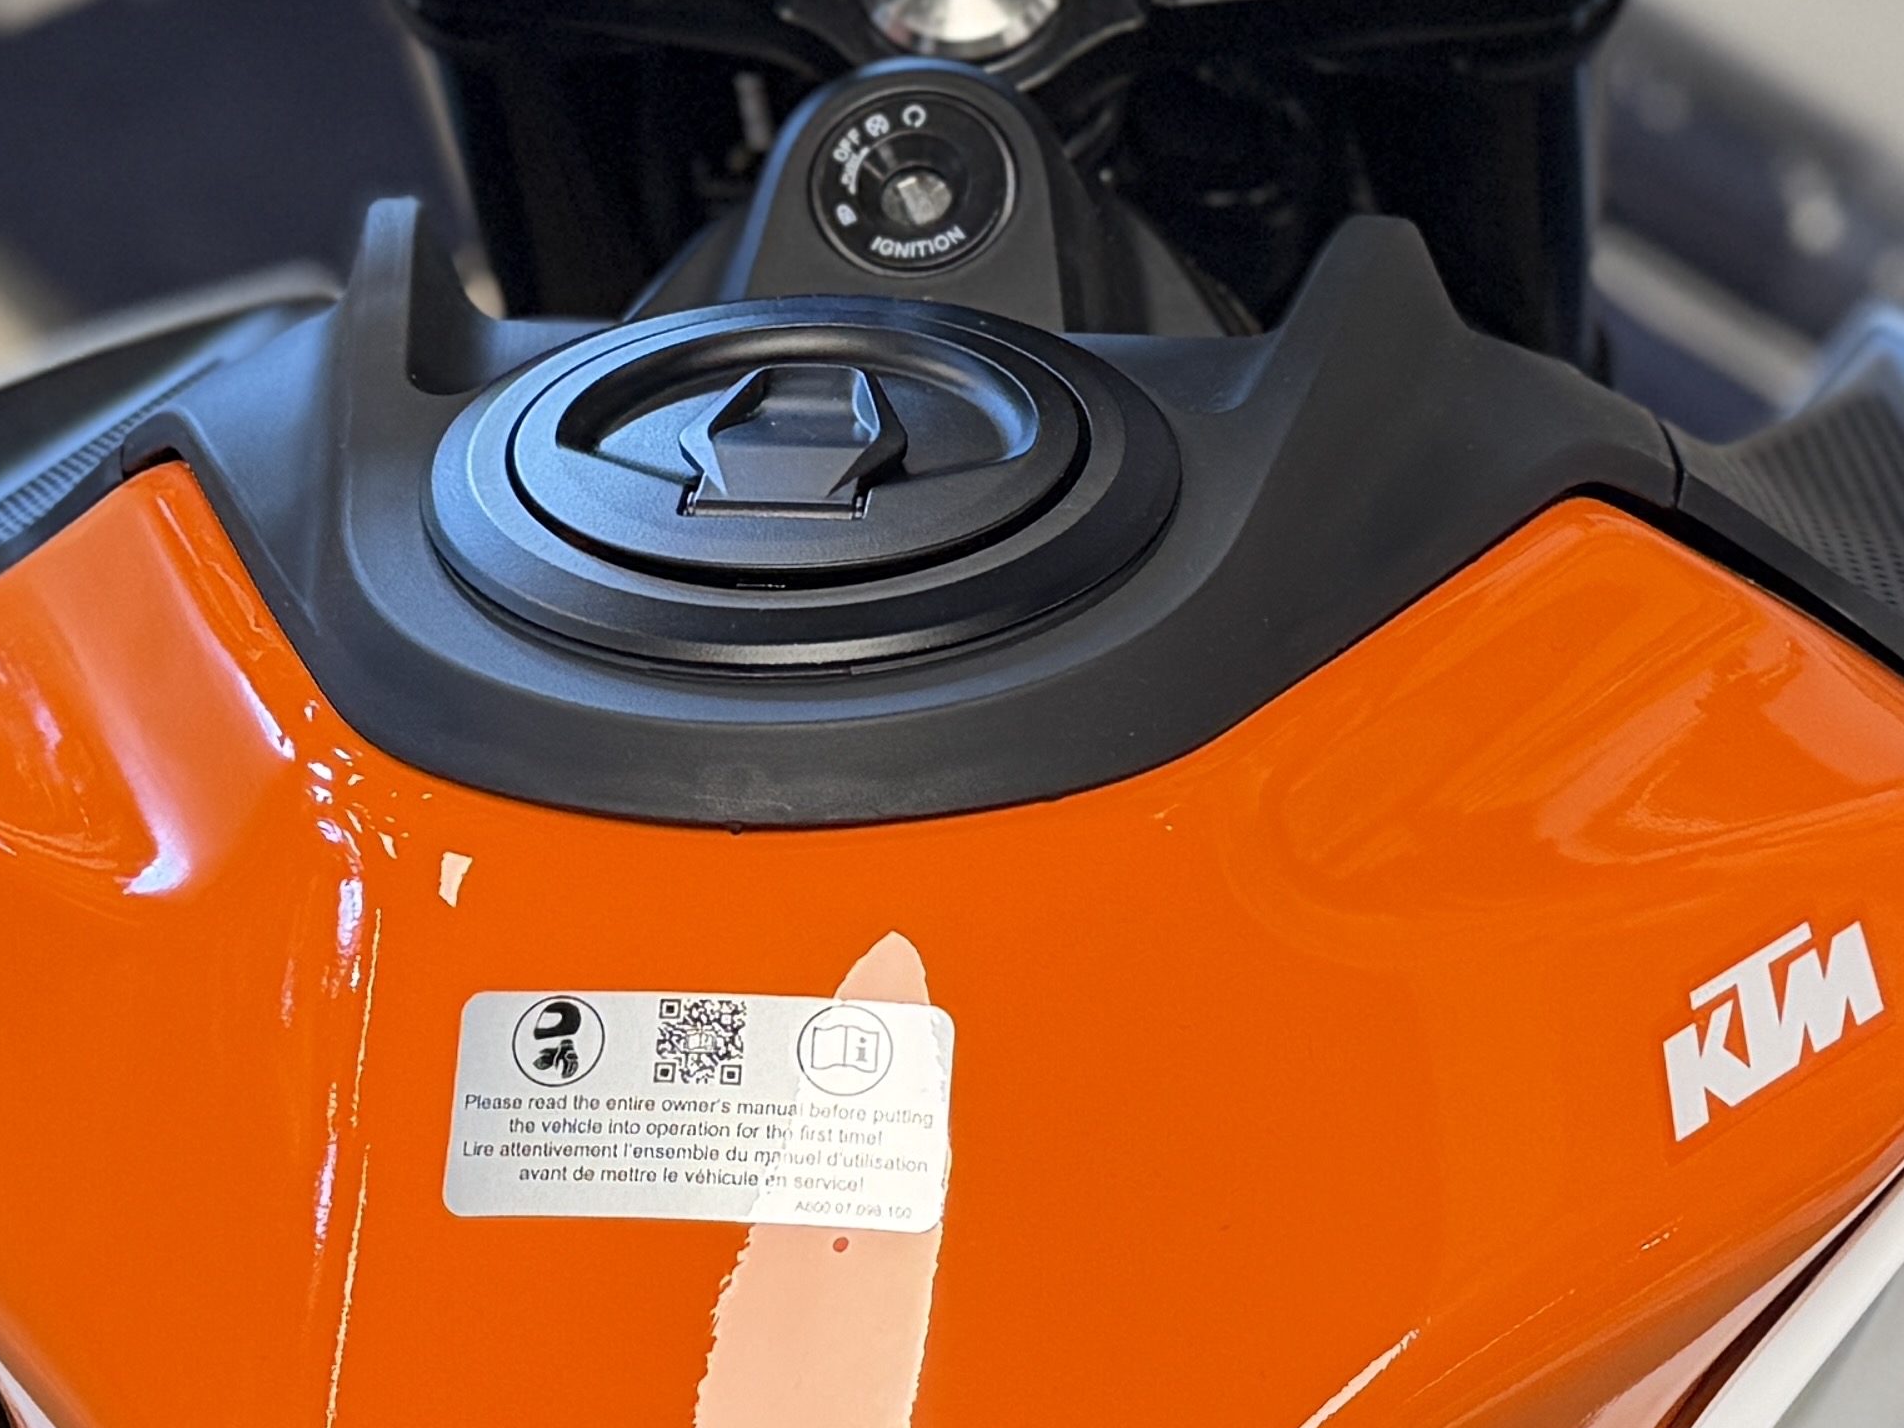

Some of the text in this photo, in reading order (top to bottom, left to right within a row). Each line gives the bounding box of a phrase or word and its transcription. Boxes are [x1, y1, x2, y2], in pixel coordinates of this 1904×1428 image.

[833, 128, 860, 162] OFF
[870, 225, 966, 259] IGNITION
[1663, 920, 1884, 1142] KTM
[464, 1094, 934, 1129] Please read the entire owner's manual before putting
[509, 1118, 883, 1146] the vehicle into operation for the first time!
[462, 1140, 929, 1173] Lire attentivement l'ensemble du manuel d'utilisation
[519, 1166, 864, 1193] avant de mettre le véhicule en service!
